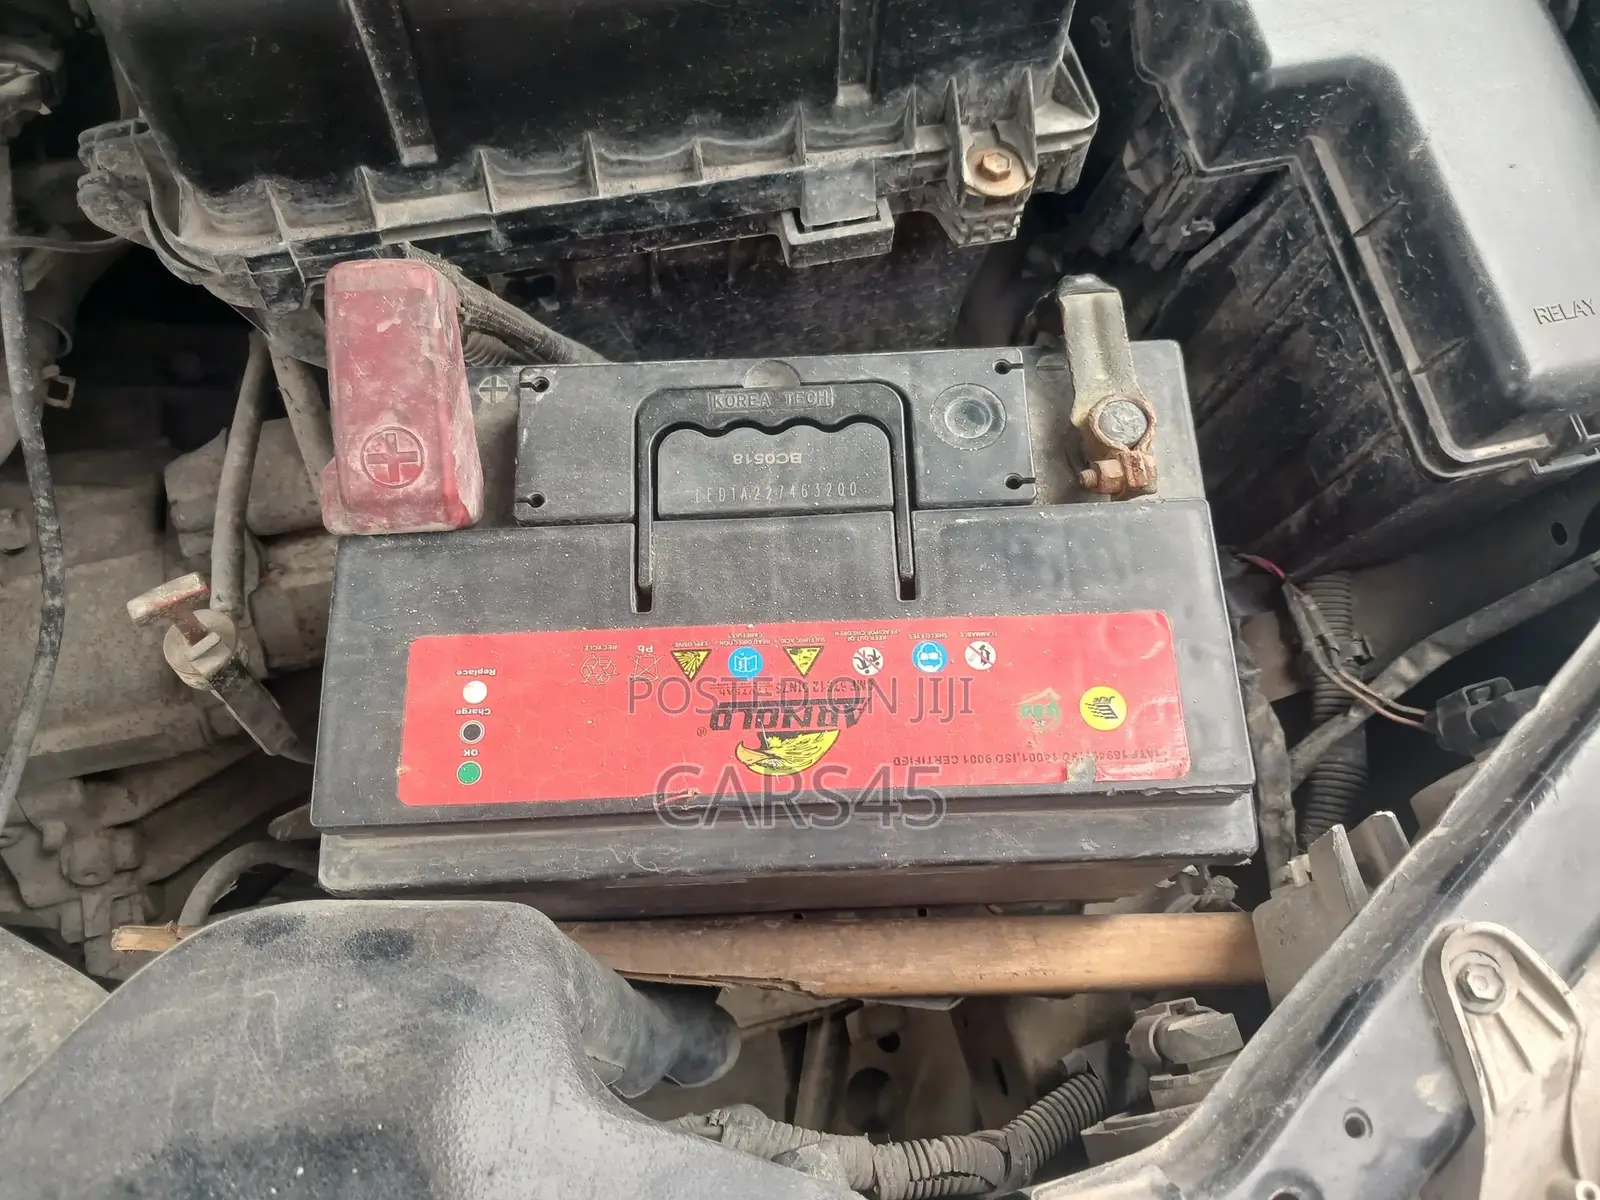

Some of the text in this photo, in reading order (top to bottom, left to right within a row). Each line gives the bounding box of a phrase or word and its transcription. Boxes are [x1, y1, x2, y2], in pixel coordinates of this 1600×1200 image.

[1533, 298, 1595, 324] RELAY
[712, 389, 830, 409] KOREA TECH
[732, 453, 802, 465] BC0518
[637, 644, 654, 652] Pb
[674, 640, 708, 648] EXPLOSIVE
[456, 668, 496, 676] Replace
[455, 707, 492, 716] Charge
[709, 704, 867, 731] ARNOLD
[462, 748, 478, 756] OK
[892, 755, 959, 766] CERTIFIED
[963, 754, 992, 764] 9001
